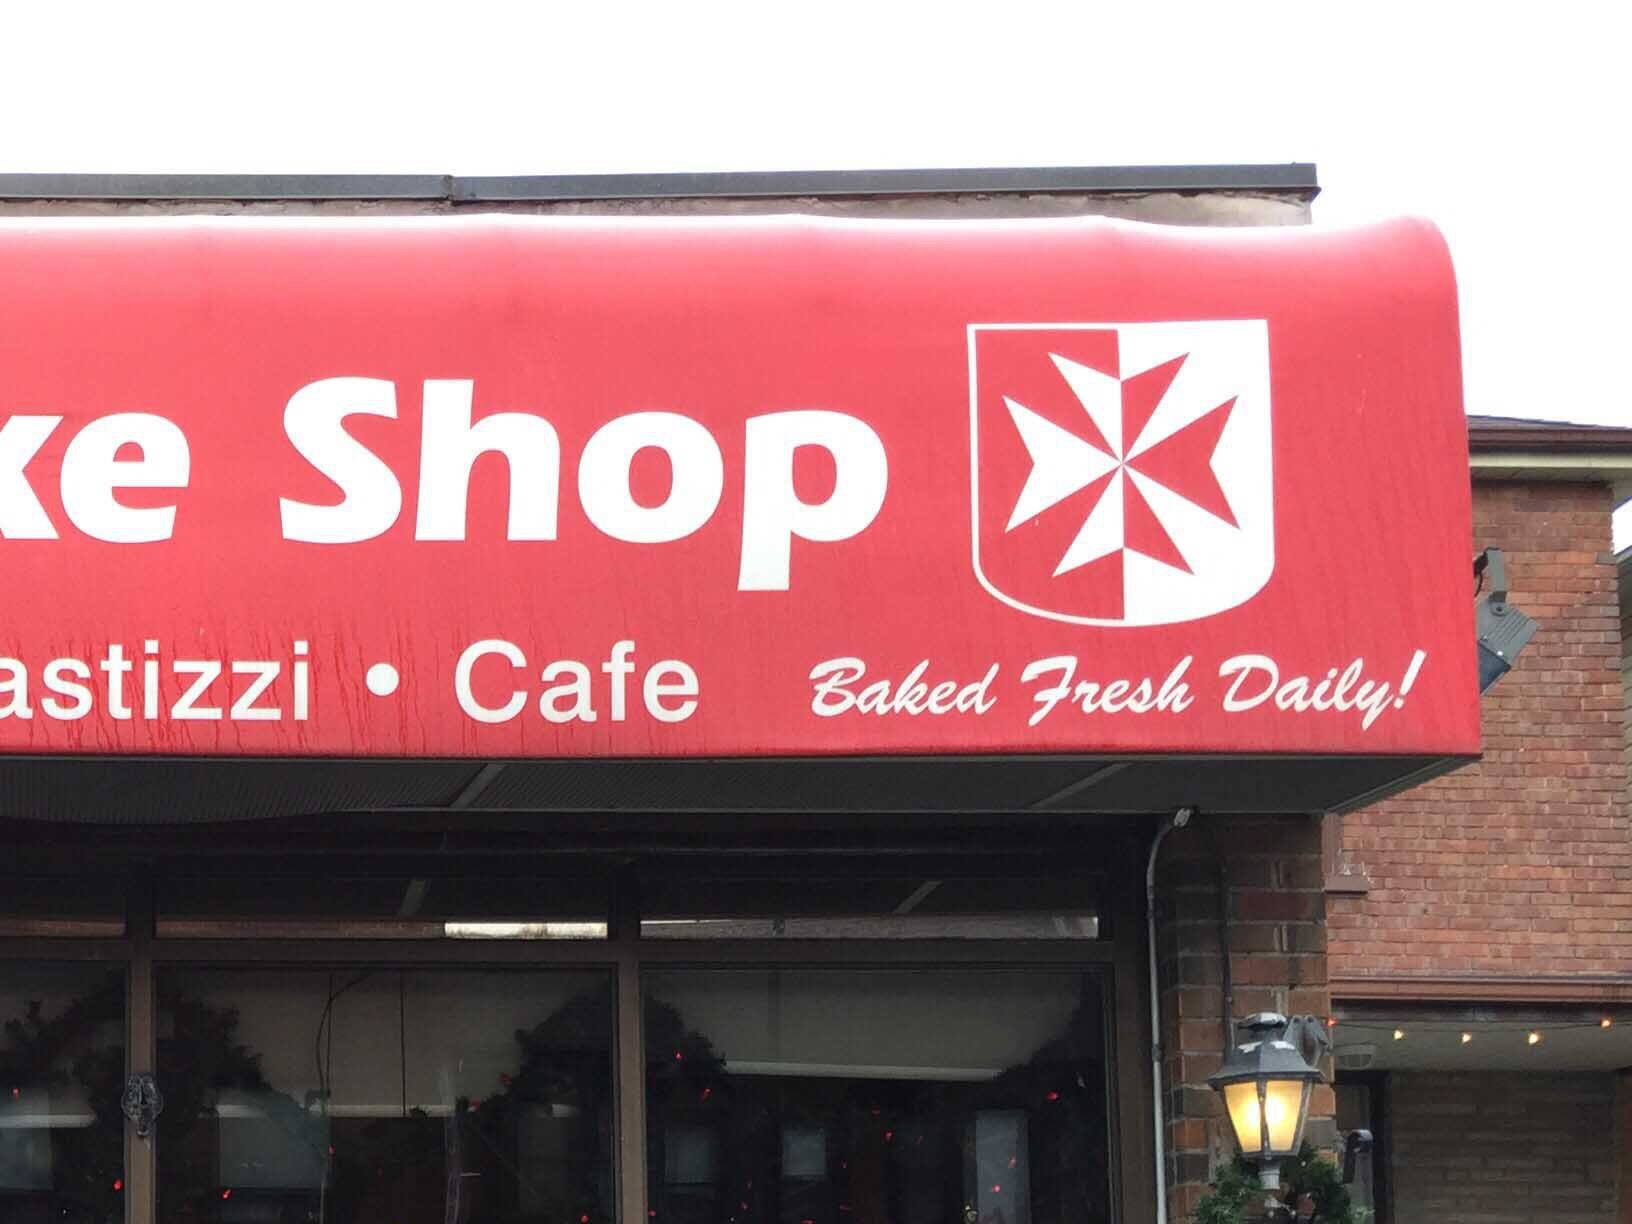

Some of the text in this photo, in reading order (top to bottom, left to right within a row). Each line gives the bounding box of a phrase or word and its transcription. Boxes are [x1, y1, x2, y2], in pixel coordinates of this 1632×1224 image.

[280, 377, 888, 590] Shop
[455, 639, 699, 723] Cafe
[809, 649, 1427, 730] Baked Fresh Daily!
